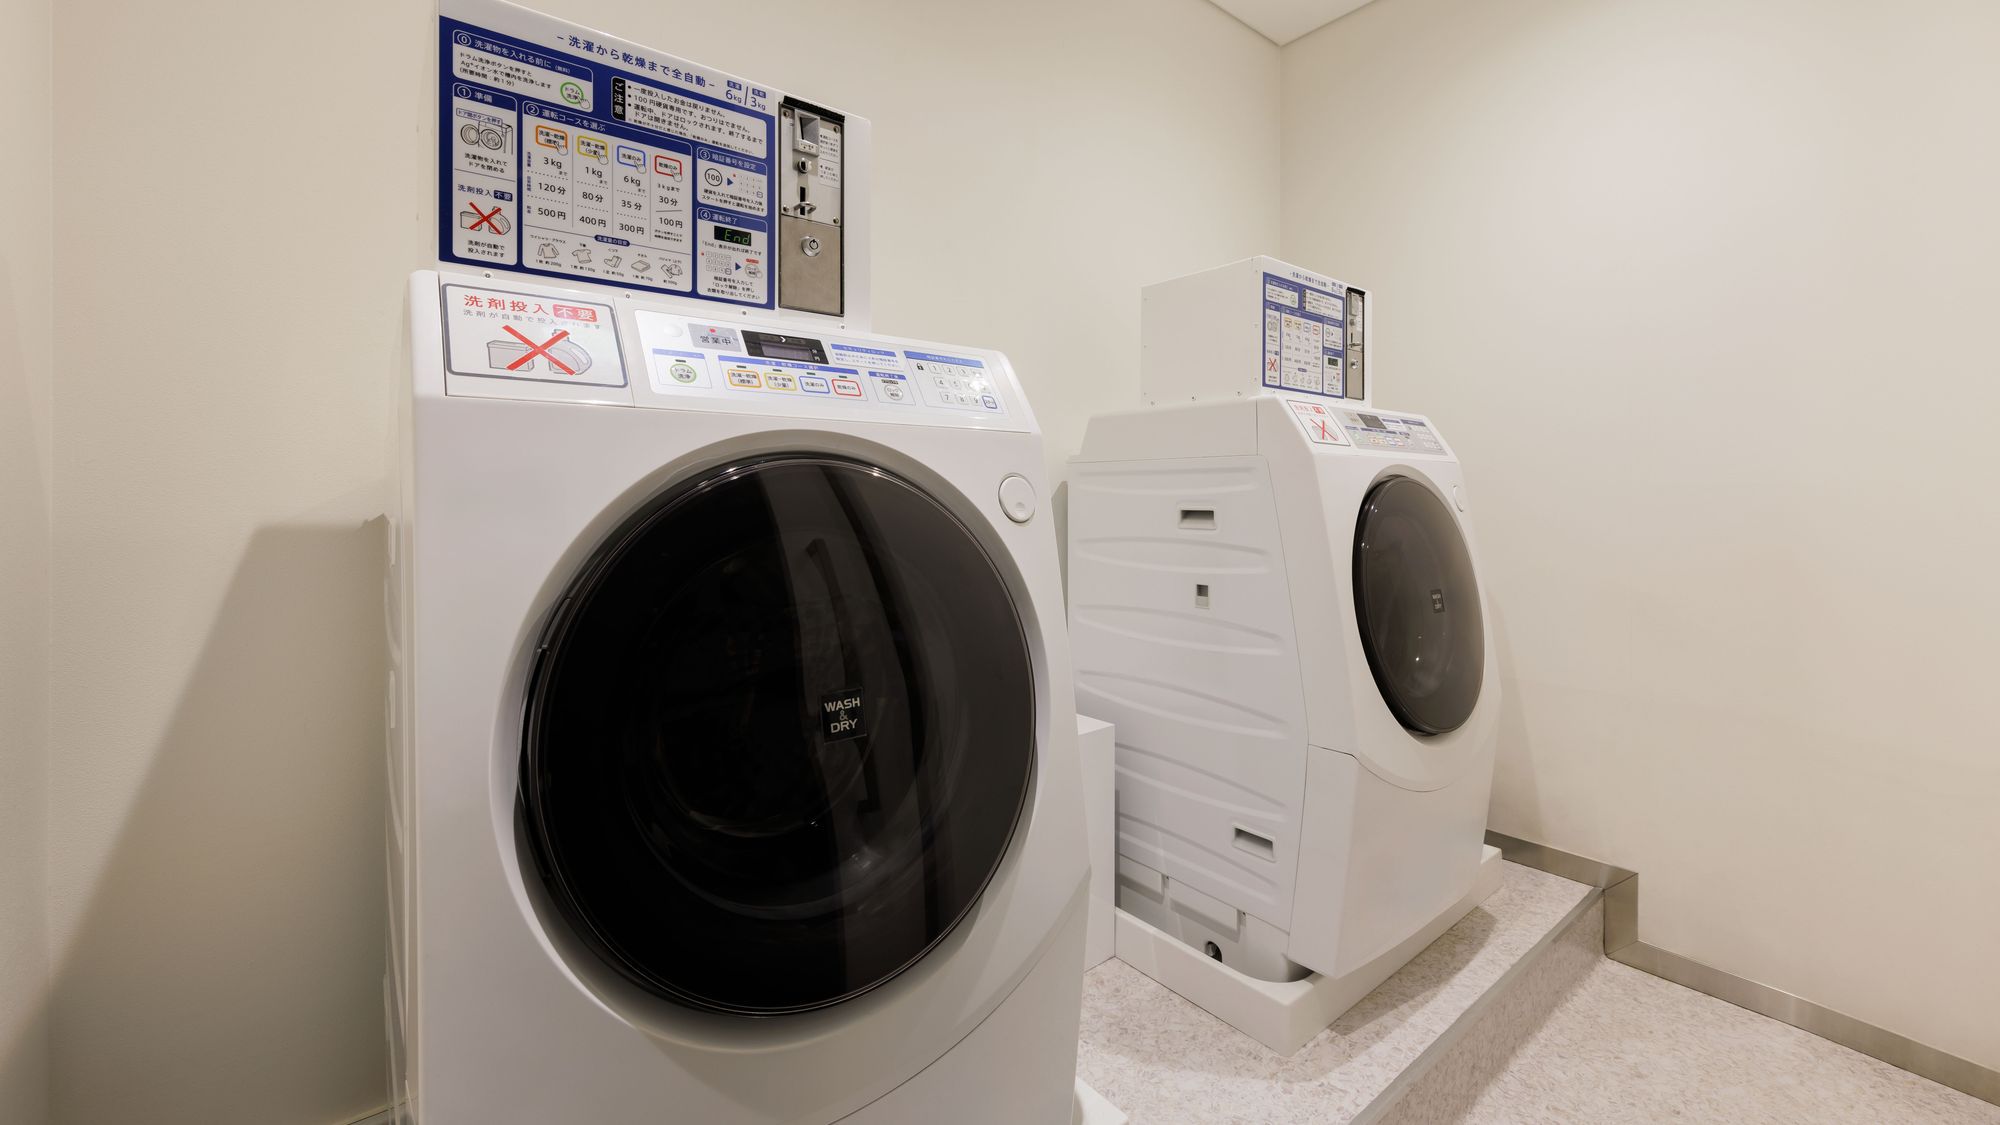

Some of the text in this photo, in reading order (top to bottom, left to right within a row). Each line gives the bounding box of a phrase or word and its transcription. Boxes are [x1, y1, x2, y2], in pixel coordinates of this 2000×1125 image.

[474, 39, 552, 69] 洗濯物を入れる前に
[569, 34, 706, 88] 洗濯から乾燥まで全自動
[460, 52, 532, 77] ドラム洗浄ボタンを押すと
[475, 91, 492, 103] 準備
[614, 81, 624, 115] ご注意
[541, 110, 606, 132] 運転コースを選ぶ
[464, 152, 508, 168] 洗濯物を入れて
[468, 161, 505, 174] ドアを閉める
[712, 153, 756, 171] 暗証番号を設定
[707, 173, 720, 182] 100
[457, 184, 512, 202] 洗剤投入 不要
[712, 213, 737, 224] 運転終了
[724, 229, 751, 245] End
[467, 240, 505, 250] 洗剤が自動で
[467, 247, 505, 258] 投入されます
[463, 294, 594, 321] 洗剤投入 不要
[700, 335, 731, 346] 営業中
[824, 697, 861, 712] WASH
[840, 709, 848, 720] &
[830, 718, 858, 733] DRY
